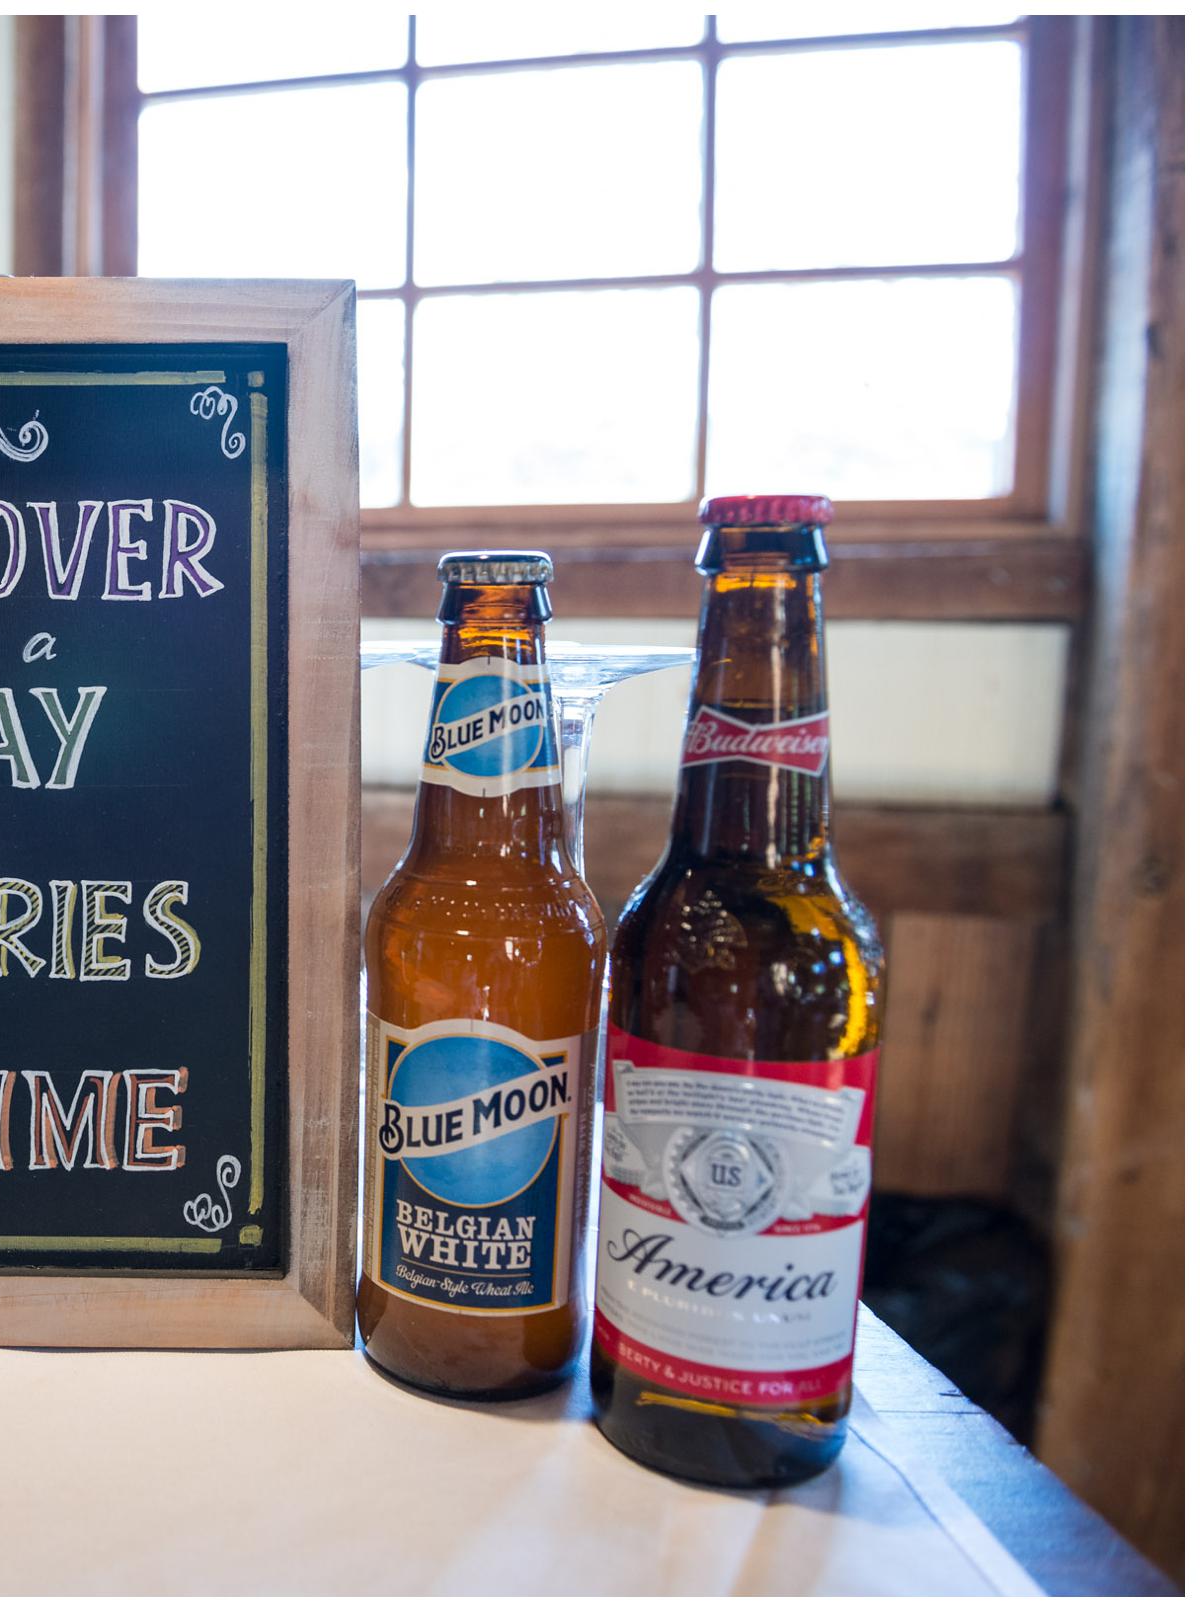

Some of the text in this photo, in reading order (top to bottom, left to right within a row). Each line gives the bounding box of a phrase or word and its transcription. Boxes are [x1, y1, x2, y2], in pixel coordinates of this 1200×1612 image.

[22, 631, 57, 664] a
[431, 699, 544, 759] BLUE MOON
[379, 1101, 464, 1154] BLUE
[711, 1163, 743, 1187] US
[396, 1199, 537, 1240] BELGIAN
[397, 1225, 532, 1270] WHITE
[607, 1229, 839, 1302] America
[396, 1263, 535, 1297] Belgian-Style Wheat Ale
[664, 1364, 676, 1380] &
[678, 1372, 753, 1395] JUSTICE
[758, 1381, 794, 1396] FOR
